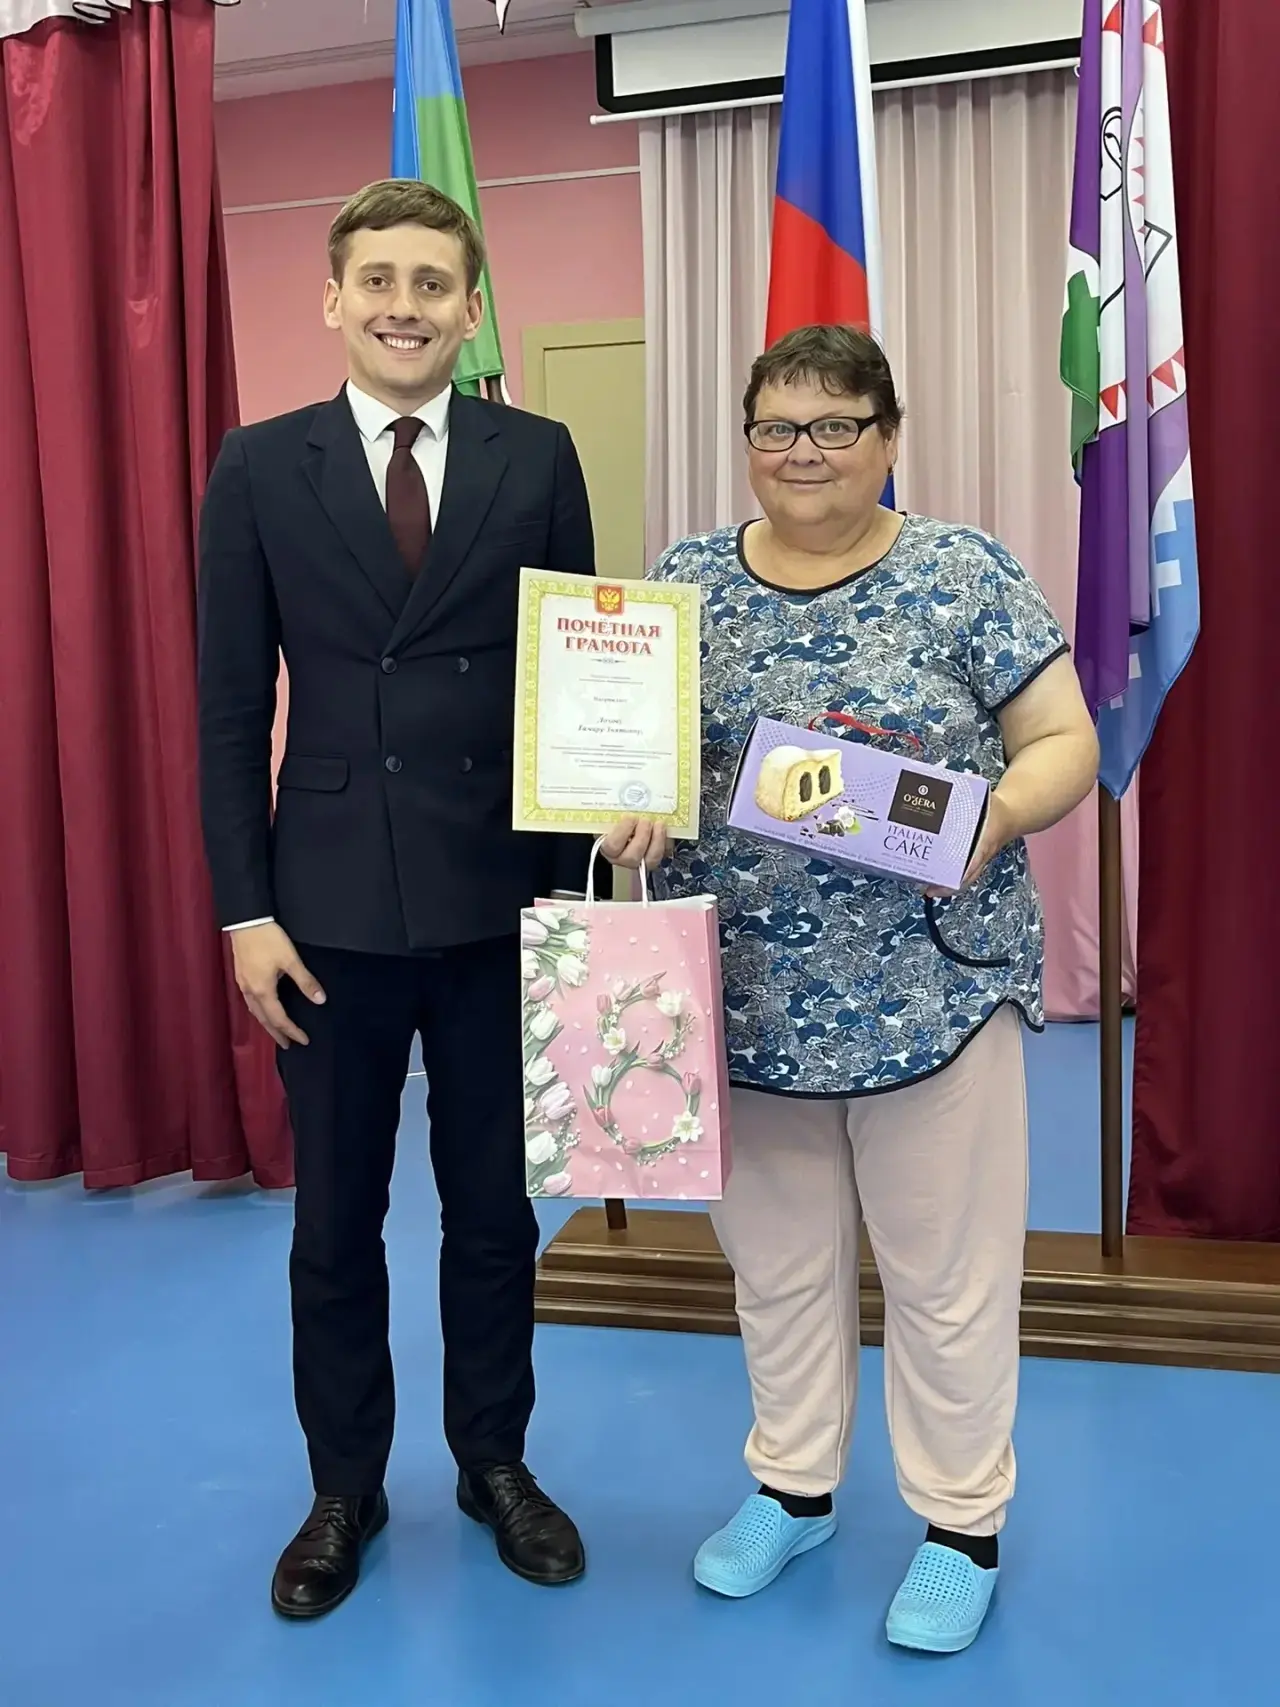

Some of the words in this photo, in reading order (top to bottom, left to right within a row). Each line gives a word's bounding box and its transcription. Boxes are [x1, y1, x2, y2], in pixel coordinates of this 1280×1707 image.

[557, 617, 661, 638] ПОЧЁТНАЯ
[565, 636, 652, 655] ГРАМОТА
[888, 825, 934, 845] ITALIAN
[883, 835, 932, 861] CAKE
